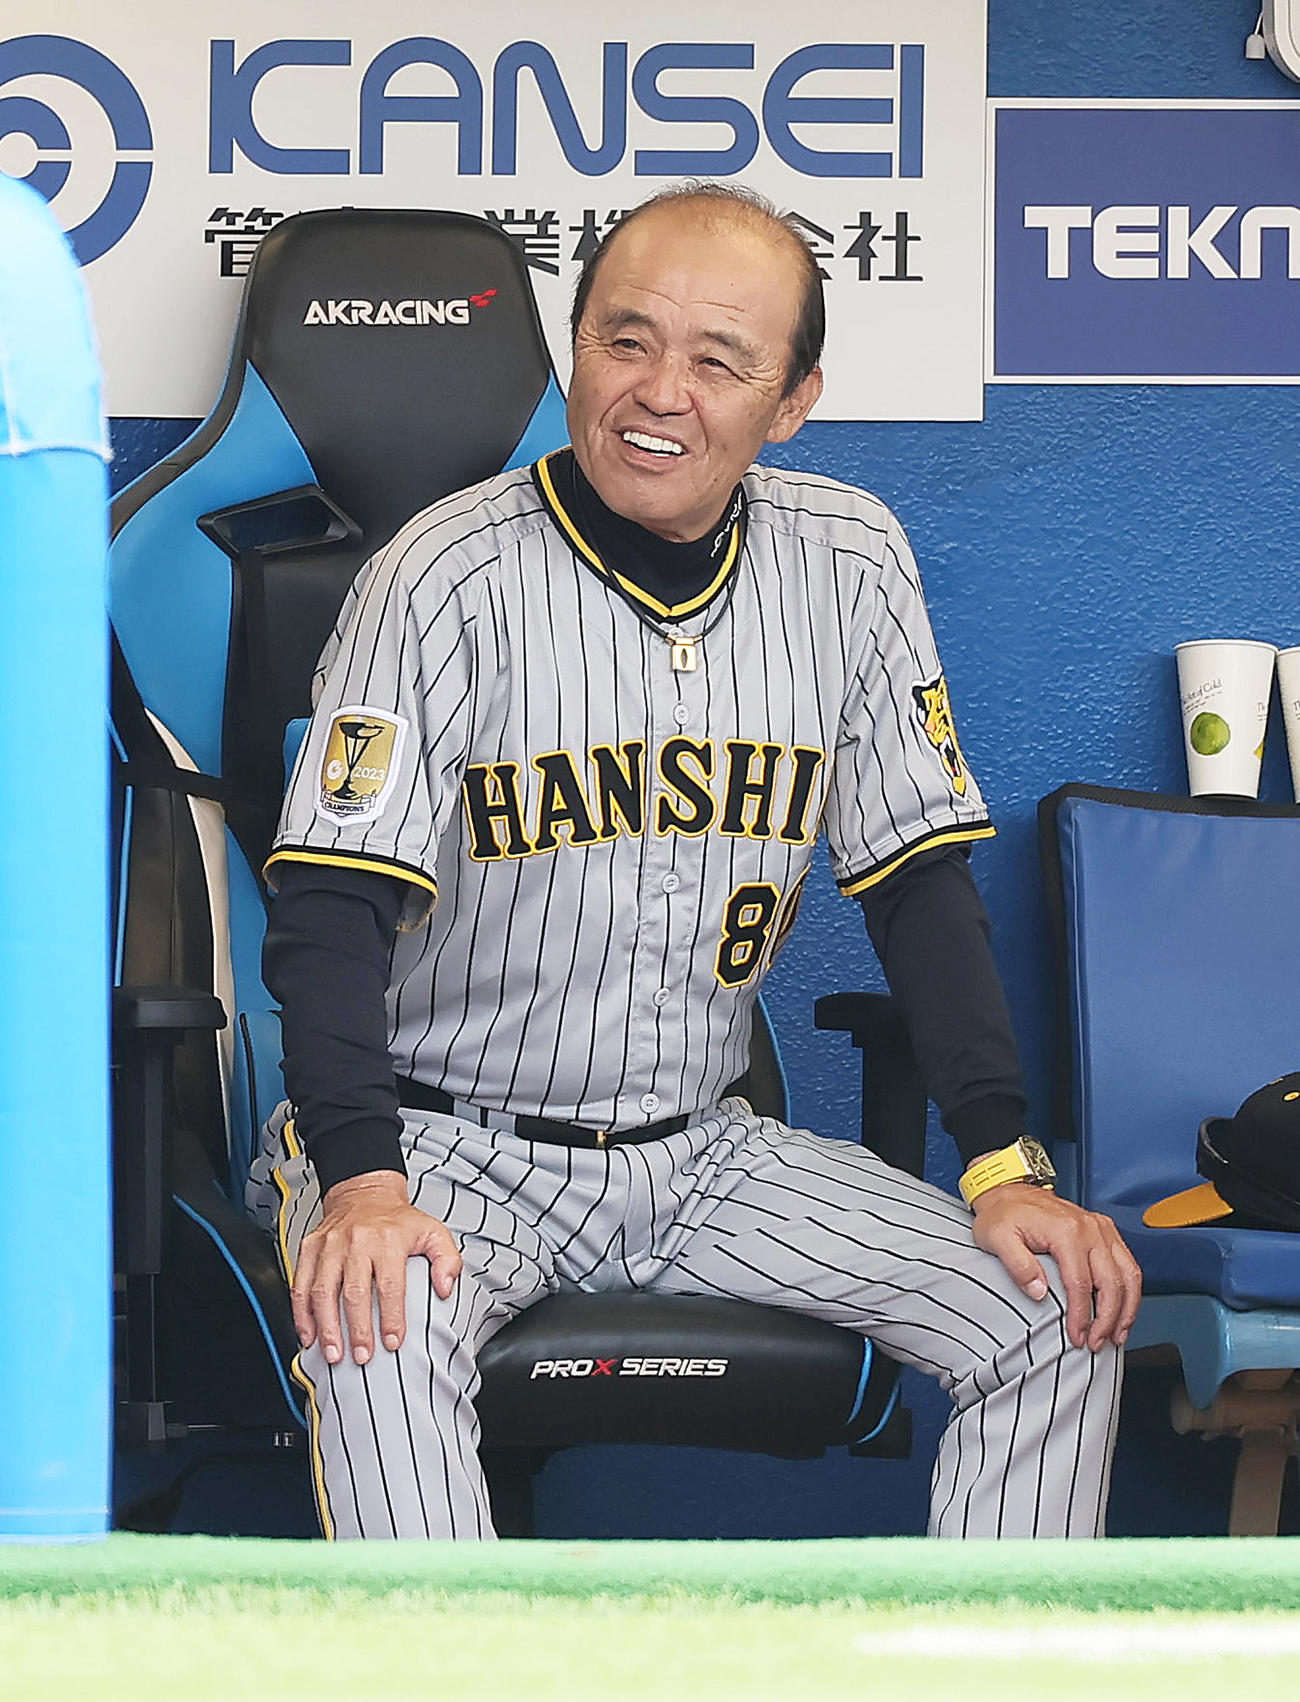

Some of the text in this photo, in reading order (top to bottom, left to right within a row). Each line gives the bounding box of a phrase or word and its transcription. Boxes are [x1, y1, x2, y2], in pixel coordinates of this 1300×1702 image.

[208, 37, 925, 179] KANSEI
[303, 299, 470, 325] AKRACING
[353, 766, 385, 781] 2023
[462, 735, 825, 862] HANSHI
[618, 1358, 729, 1377] SERIES
